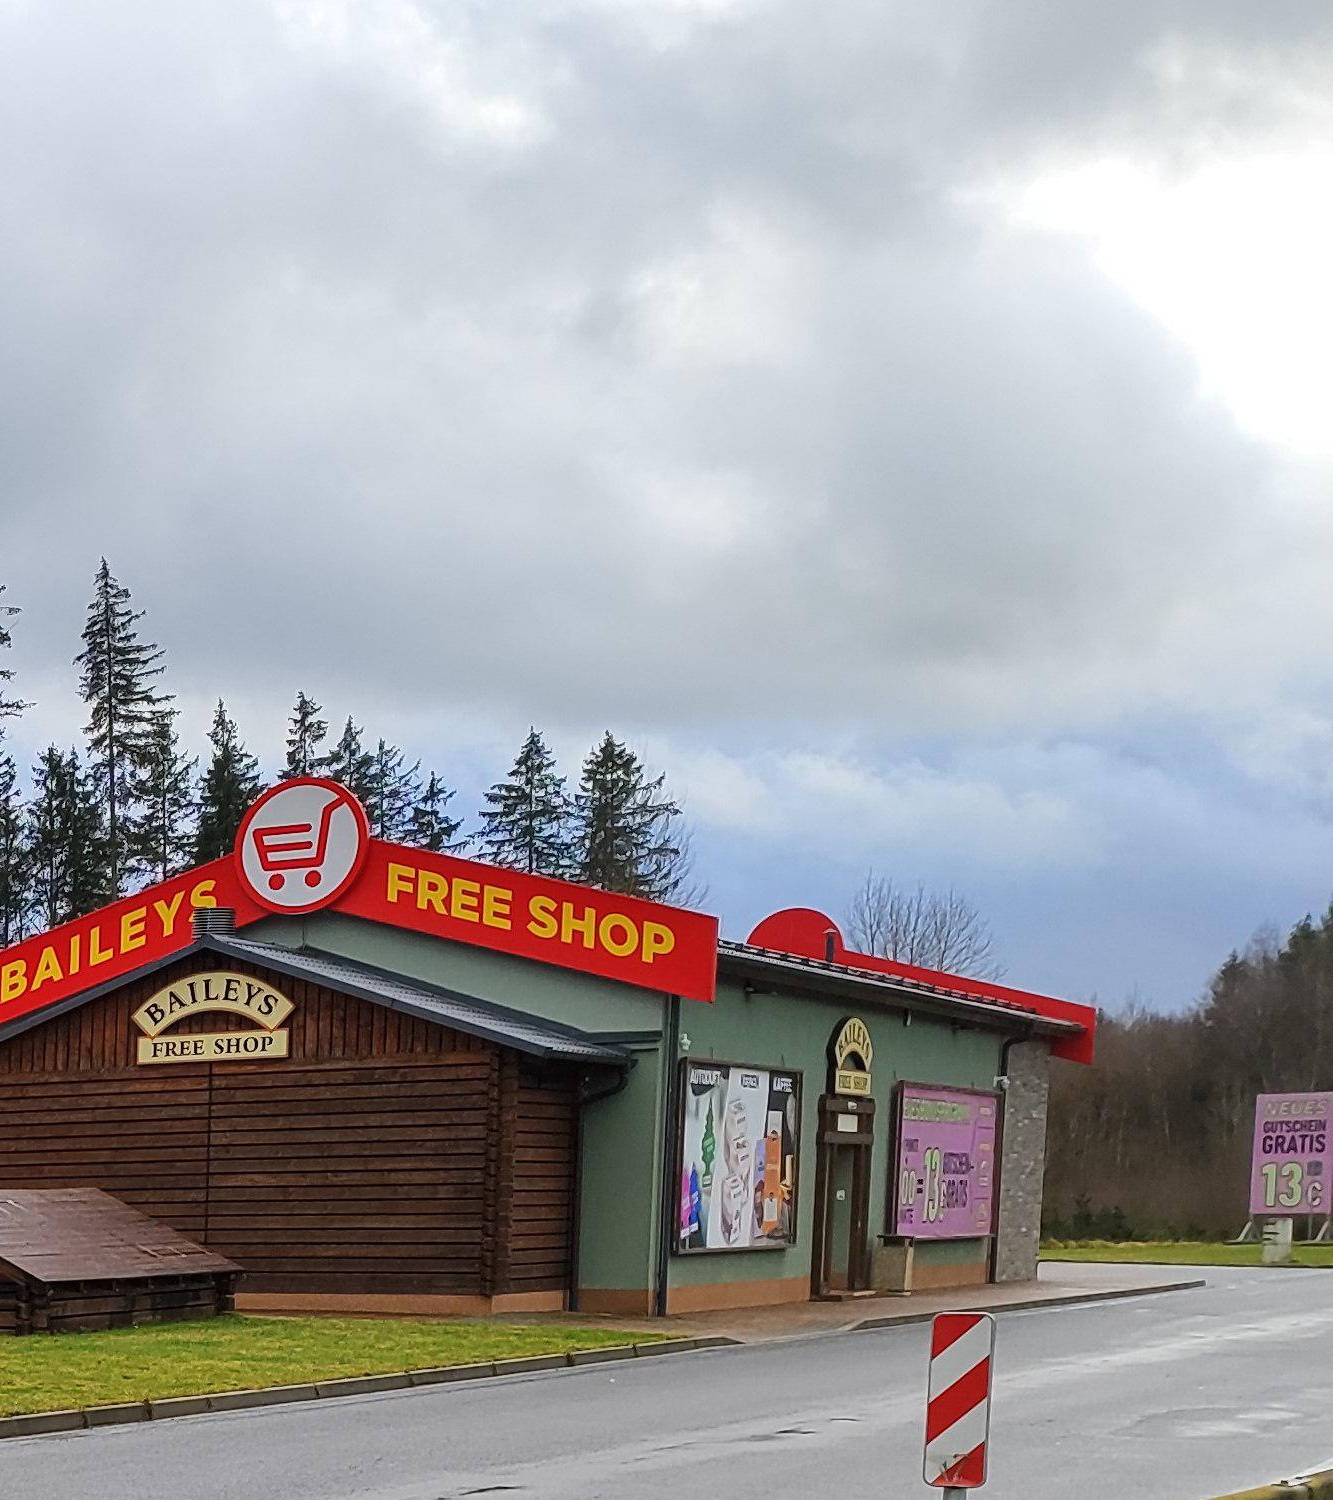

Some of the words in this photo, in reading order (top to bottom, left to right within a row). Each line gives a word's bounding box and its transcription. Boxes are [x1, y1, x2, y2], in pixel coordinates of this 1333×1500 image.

[387, 862, 513, 931] FREE
[526, 895, 676, 964] SHOP
[0, 879, 217, 1005] BAILEYS
[143, 977, 279, 1027] BAILEYS
[151, 1039, 205, 1058] FREE
[213, 1036, 274, 1055] SHOP
[1265, 1101, 1327, 1116] NEUES
[1263, 1119, 1327, 1133] GUTSCHEIN
[1262, 1134, 1326, 1154] GRATIS
[1261, 1161, 1303, 1208] 13
